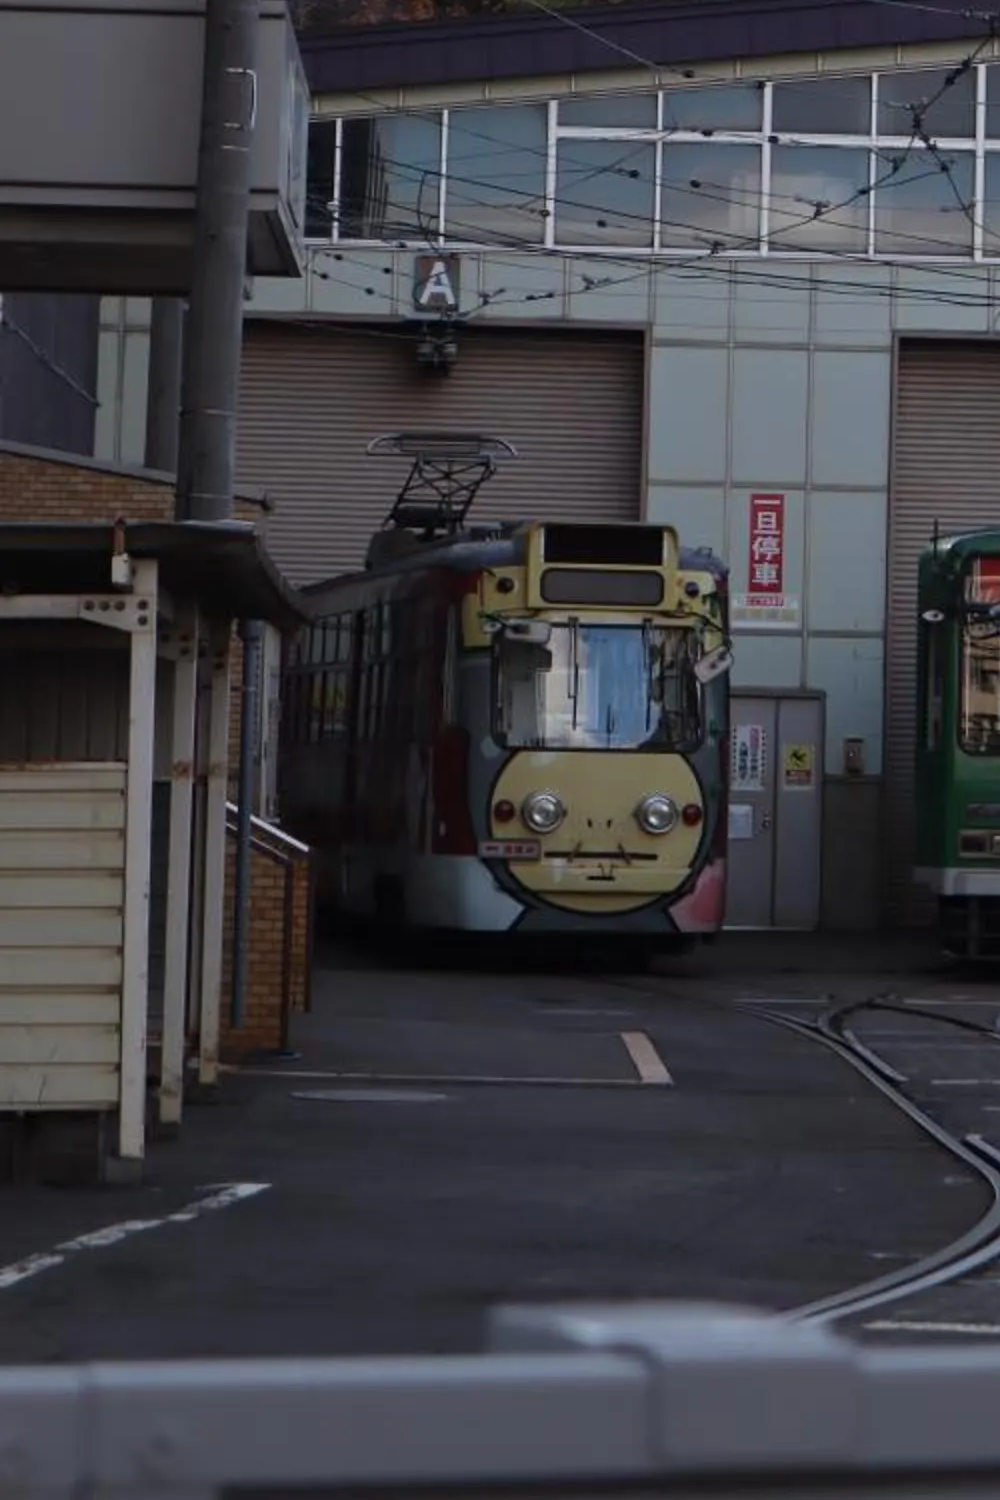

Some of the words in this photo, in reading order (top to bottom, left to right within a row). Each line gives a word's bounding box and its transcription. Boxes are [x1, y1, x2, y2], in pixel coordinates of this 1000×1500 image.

[420, 261, 455, 304] A
[752, 499, 781, 586] 一旦停車
